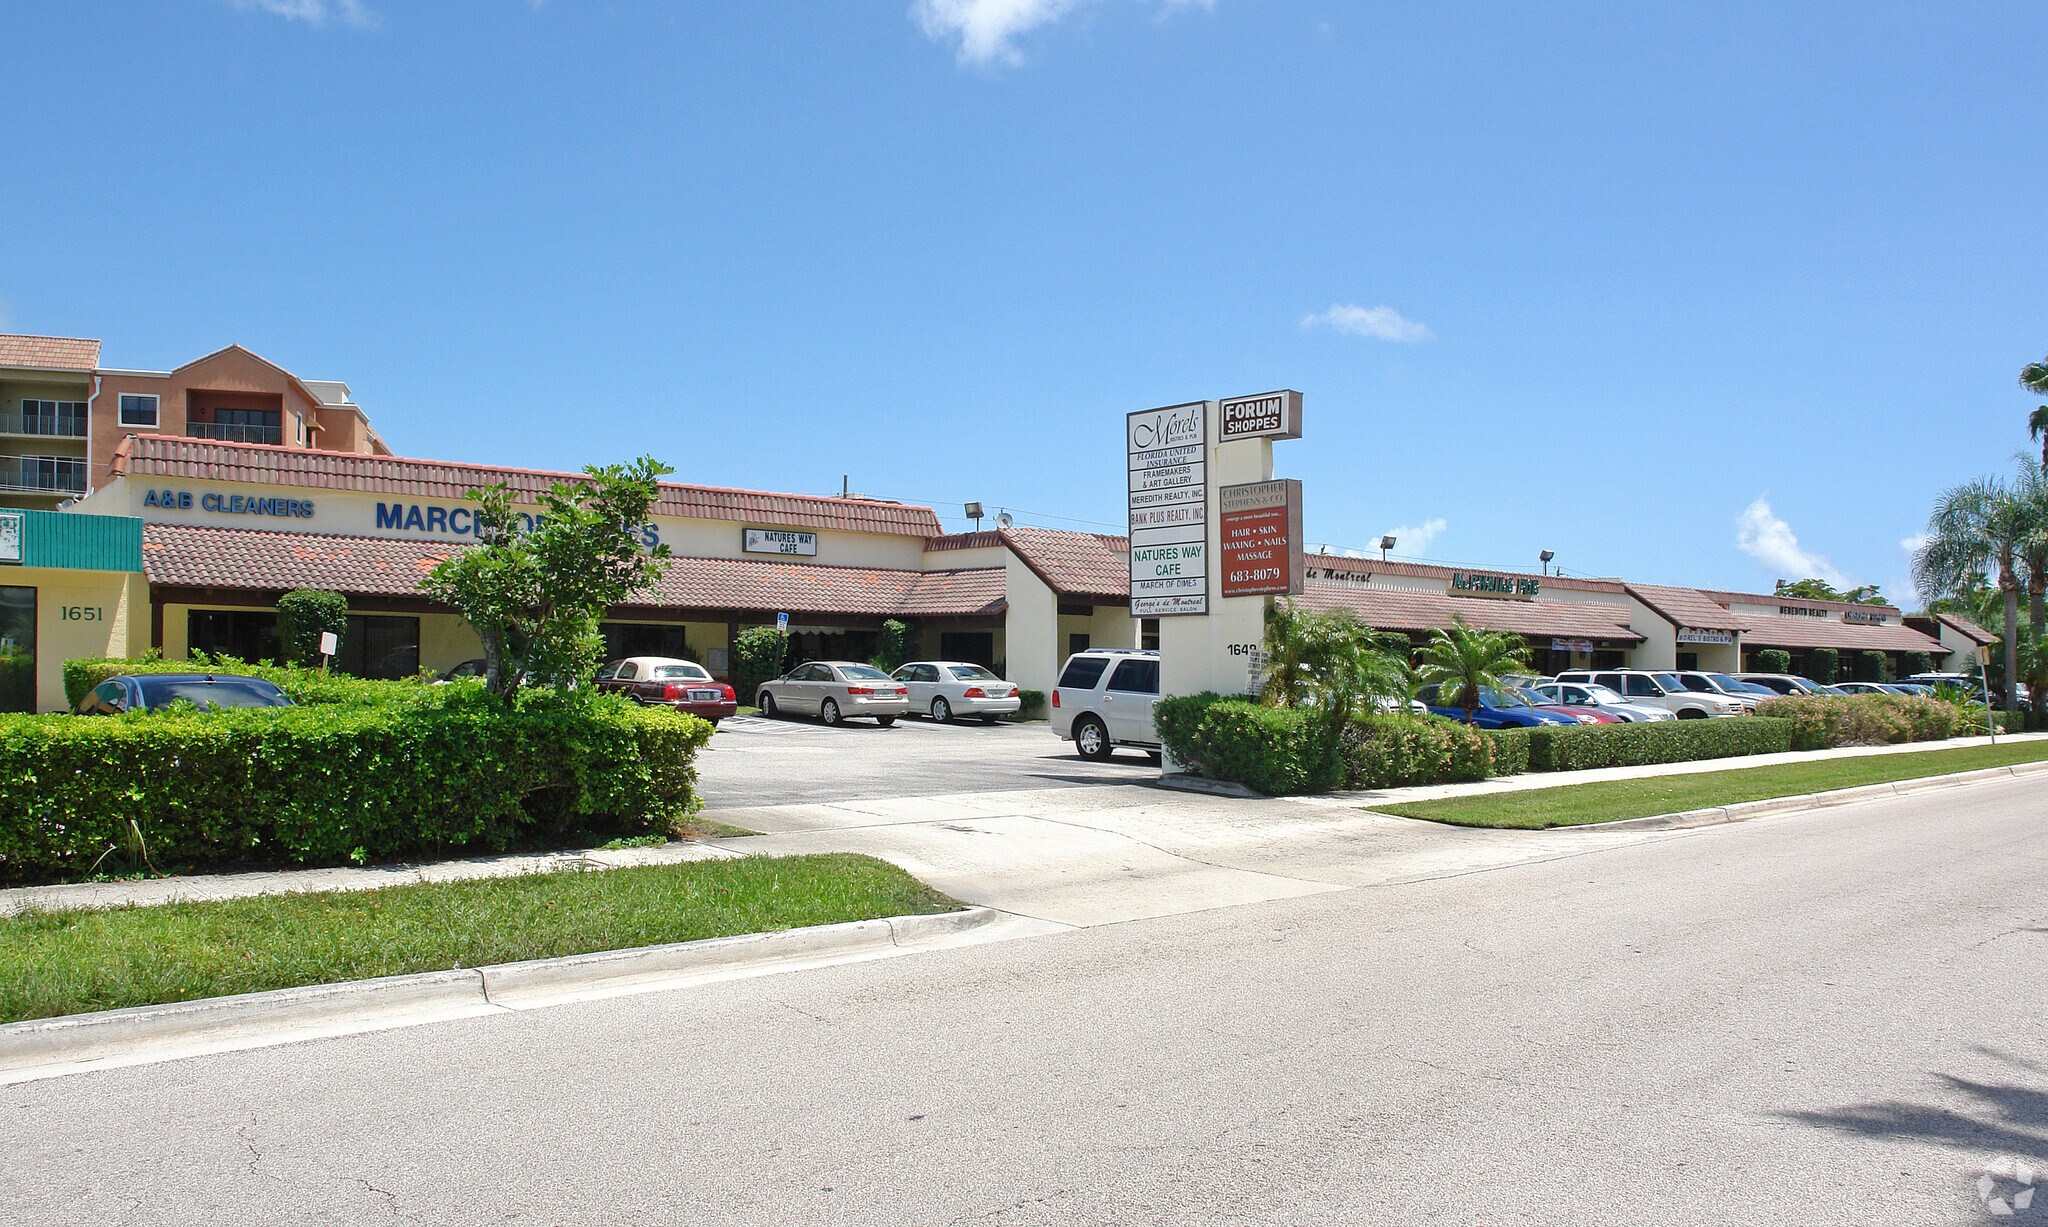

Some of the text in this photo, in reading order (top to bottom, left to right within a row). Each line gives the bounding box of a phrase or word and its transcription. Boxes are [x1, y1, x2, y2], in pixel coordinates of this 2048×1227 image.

[1225, 399, 1280, 421] FORUM
[1133, 409, 1199, 449] Morels
[1227, 416, 1278, 433] SHOPPES
[1136, 446, 1197, 461] FLORIDA UNITED
[1146, 455, 1188, 468] INSURANCE
[1143, 465, 1191, 479] FRAMEMAKERS
[1142, 475, 1192, 489] & ART GALLERY
[1131, 489, 1204, 504] MEREDITH REALTY, INC.
[1222, 482, 1284, 500] CHRISTOPHER
[144, 489, 315, 519] A&B CLEANERS
[1223, 497, 1260, 509] STEPHENS
[1261, 496, 1269, 504] &
[1131, 512, 1148, 525] BANK
[1149, 510, 1165, 524] PLUS
[764, 531, 813, 544] NATURES WAY
[1231, 525, 1277, 538] HAIR SKIN
[779, 543, 798, 554] CAFE
[1223, 536, 1287, 550] WAXING NAILS
[1134, 545, 1202, 562] NATURES WAY
[1236, 550, 1273, 561] MASSAGE
[1155, 563, 1182, 576] CAFE
[1230, 567, 1280, 583] 683-8079
[1305, 566, 1372, 583] de Montreal
[1140, 578, 1197, 590] MARCH OF DIMES
[1134, 596, 1204, 610] George's de Montreal
[61, 606, 103, 621] 1651
[1808, 608, 1828, 618] REALTY
